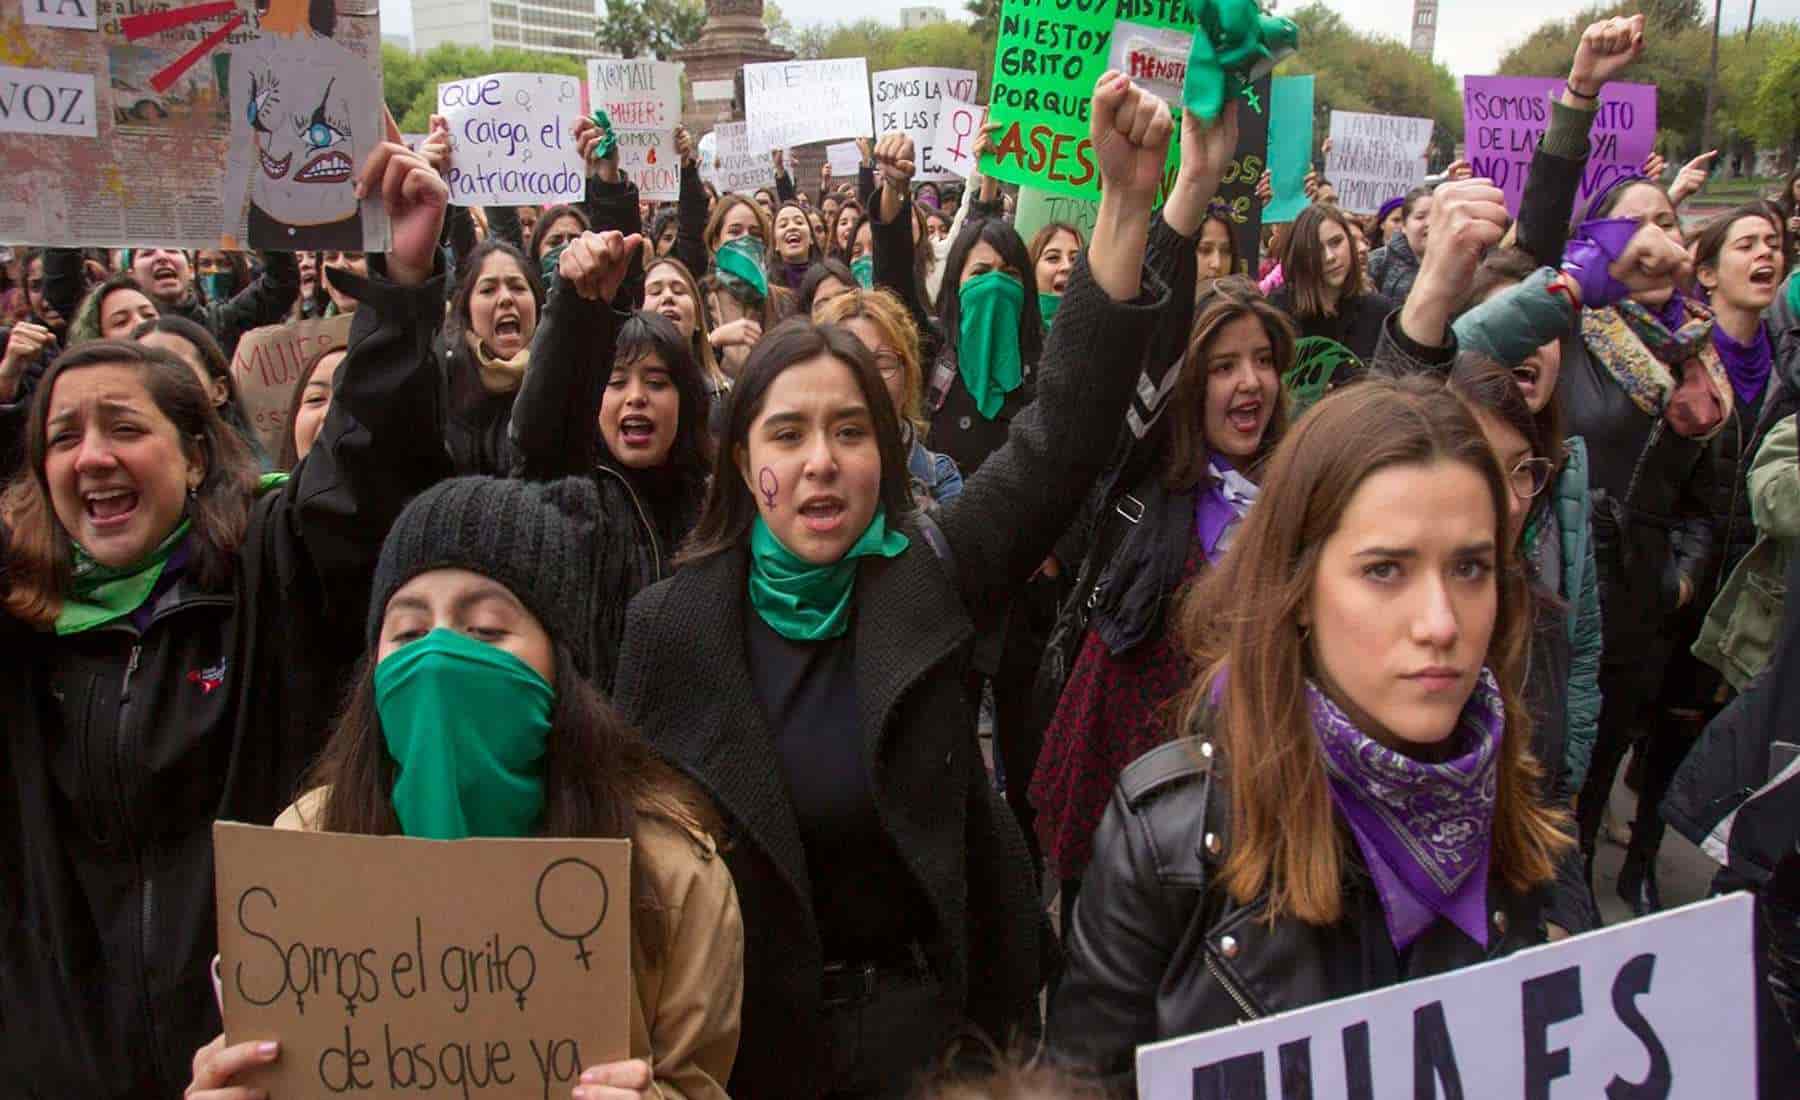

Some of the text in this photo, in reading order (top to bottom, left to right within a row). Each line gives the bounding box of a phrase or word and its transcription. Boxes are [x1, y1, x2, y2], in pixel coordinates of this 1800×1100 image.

[1035, 20, 1111, 55] ESTOY
[1001, 46, 1083, 80] GRITO
[877, 79, 920, 102] SOMOS
[925, 80, 942, 100] LA
[993, 84, 1090, 123] PORQUE
[464, 114, 562, 157] caiga el
[882, 111, 897, 131] DE
[904, 110, 929, 130] LAS
[1479, 126, 1505, 150] DE
[1592, 133, 1617, 161] YA
[1472, 156, 1509, 189] NO
[236, 886, 537, 1016] Somos el grito
[319, 1025, 374, 1093] de
[439, 1041, 515, 1100] que
[528, 1039, 583, 1100] ya
